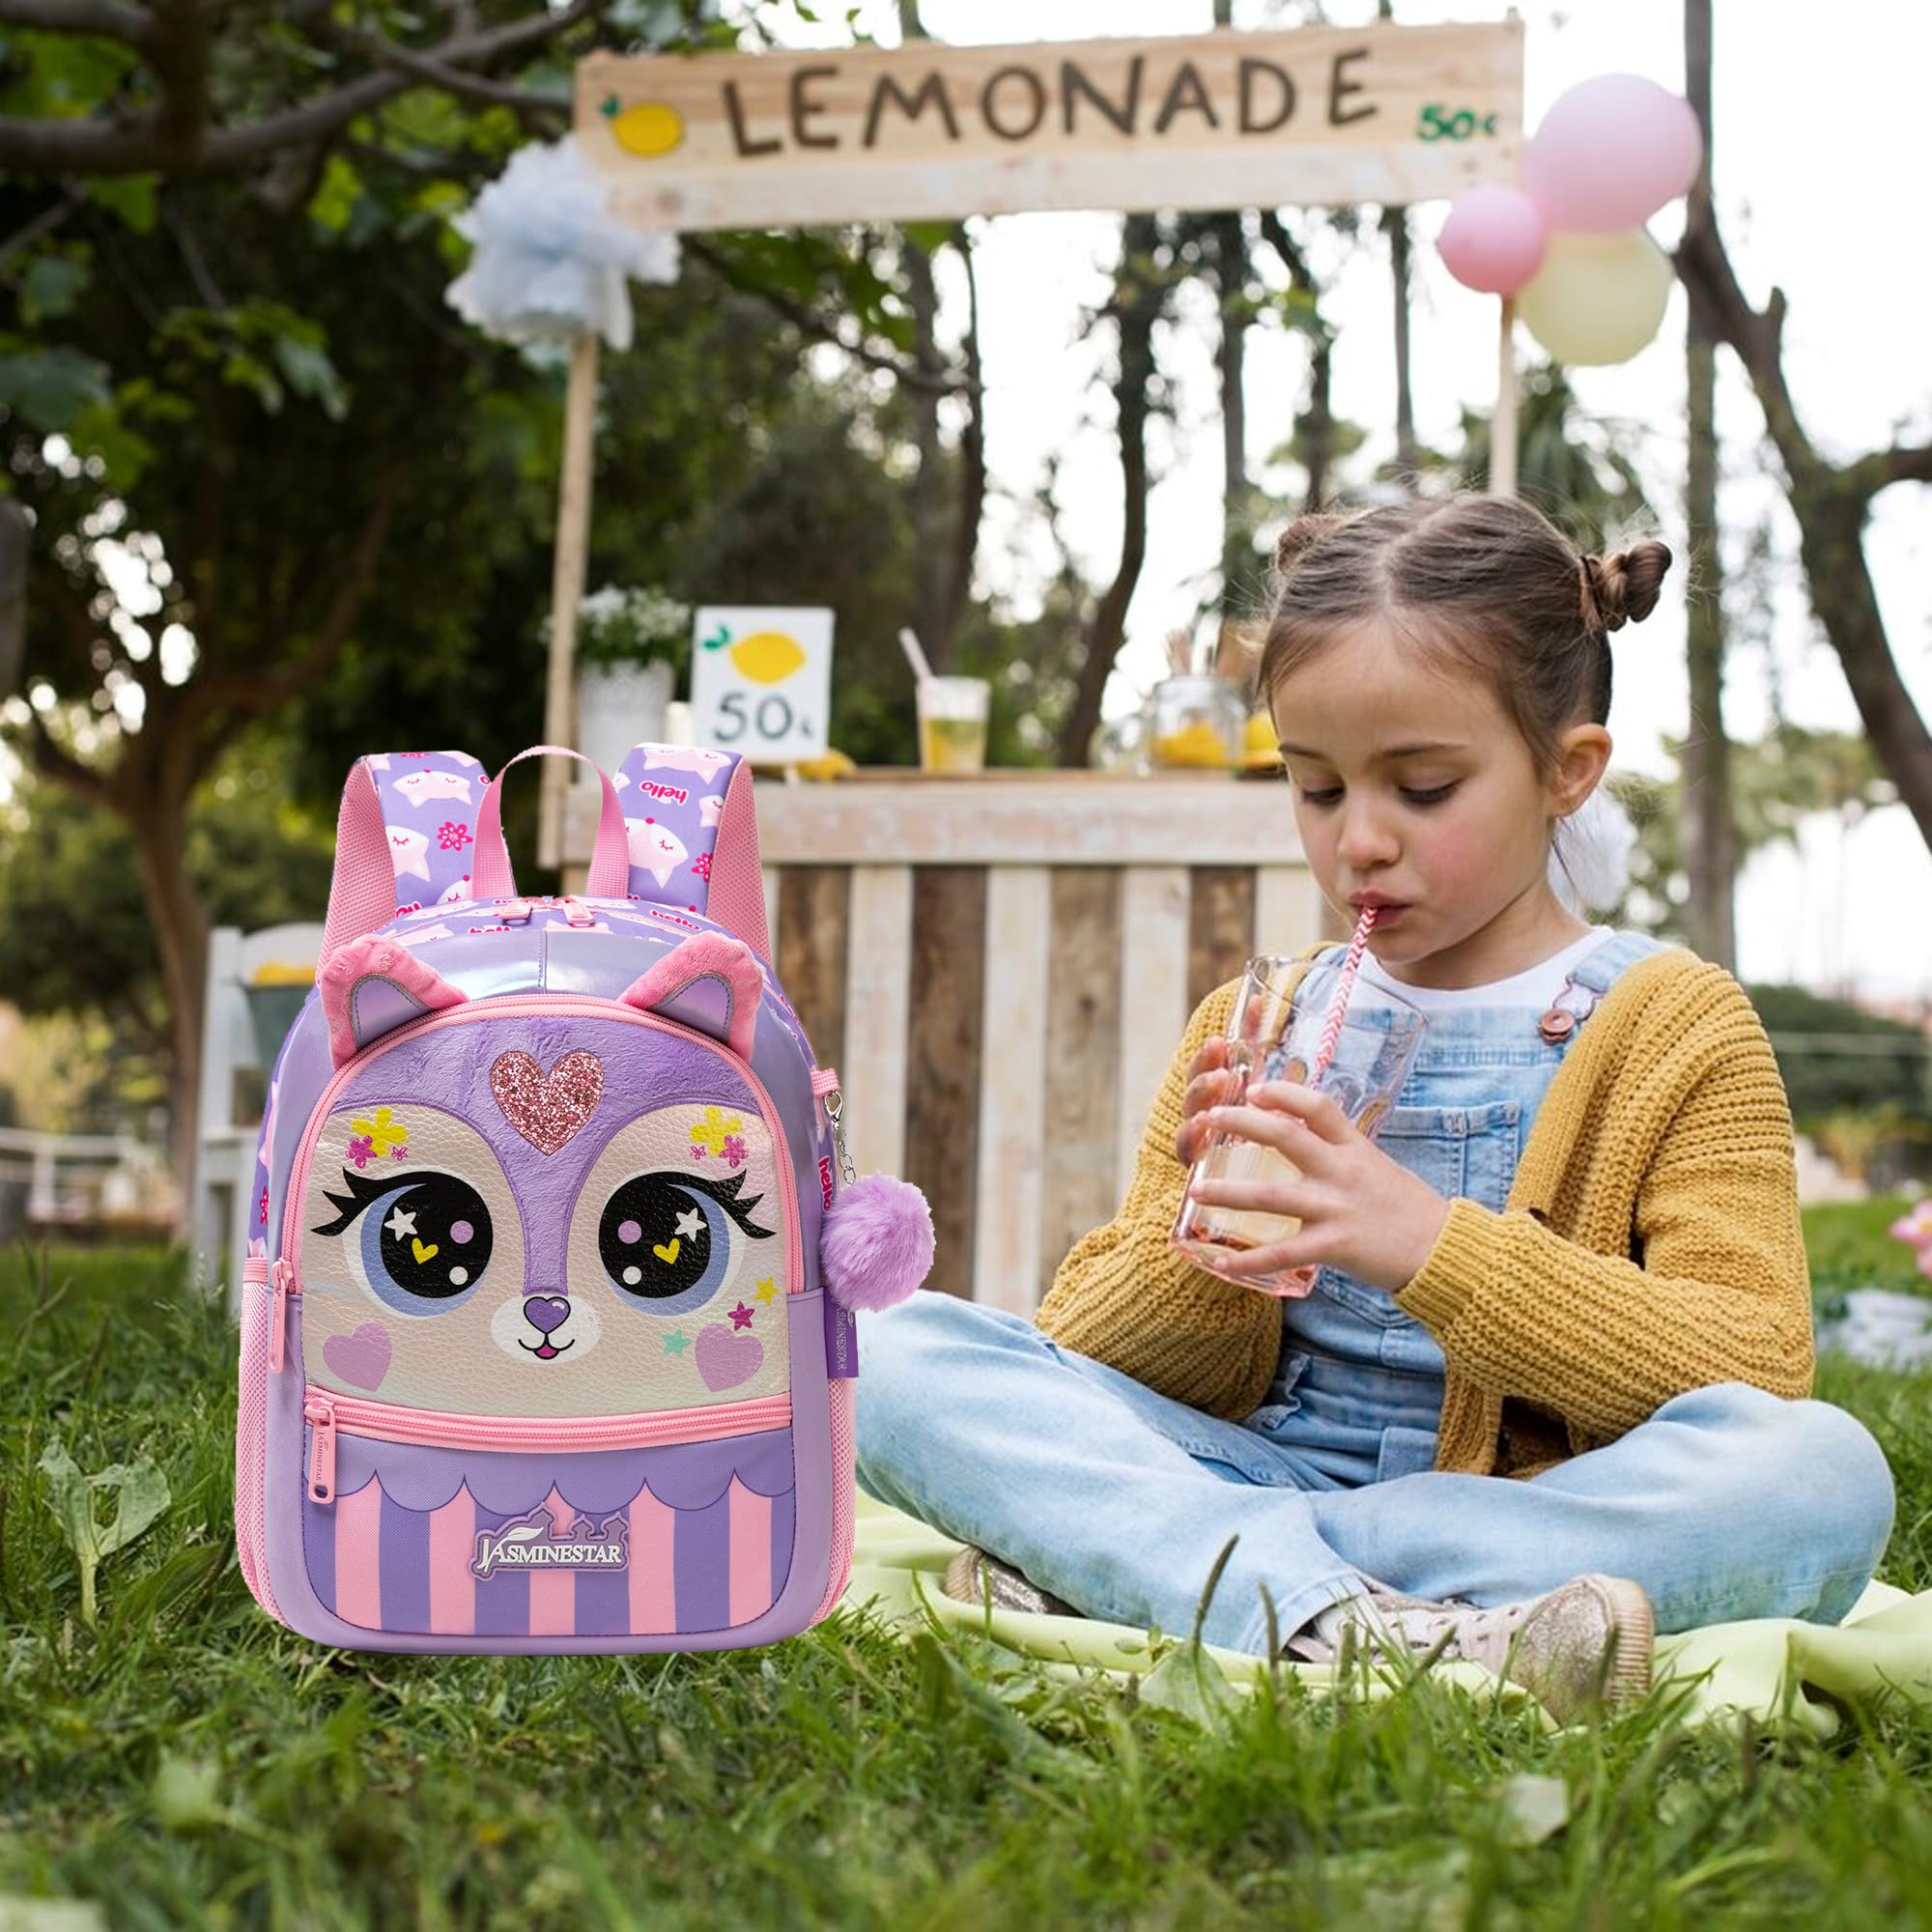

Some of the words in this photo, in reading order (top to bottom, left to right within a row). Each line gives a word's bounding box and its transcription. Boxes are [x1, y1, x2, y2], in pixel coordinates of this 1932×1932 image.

[722, 48, 1379, 157] LEMONADE
[640, 781, 687, 805] hello
[818, 1156, 833, 1212] hello
[476, 1537, 622, 1574] JASMINESTAR
